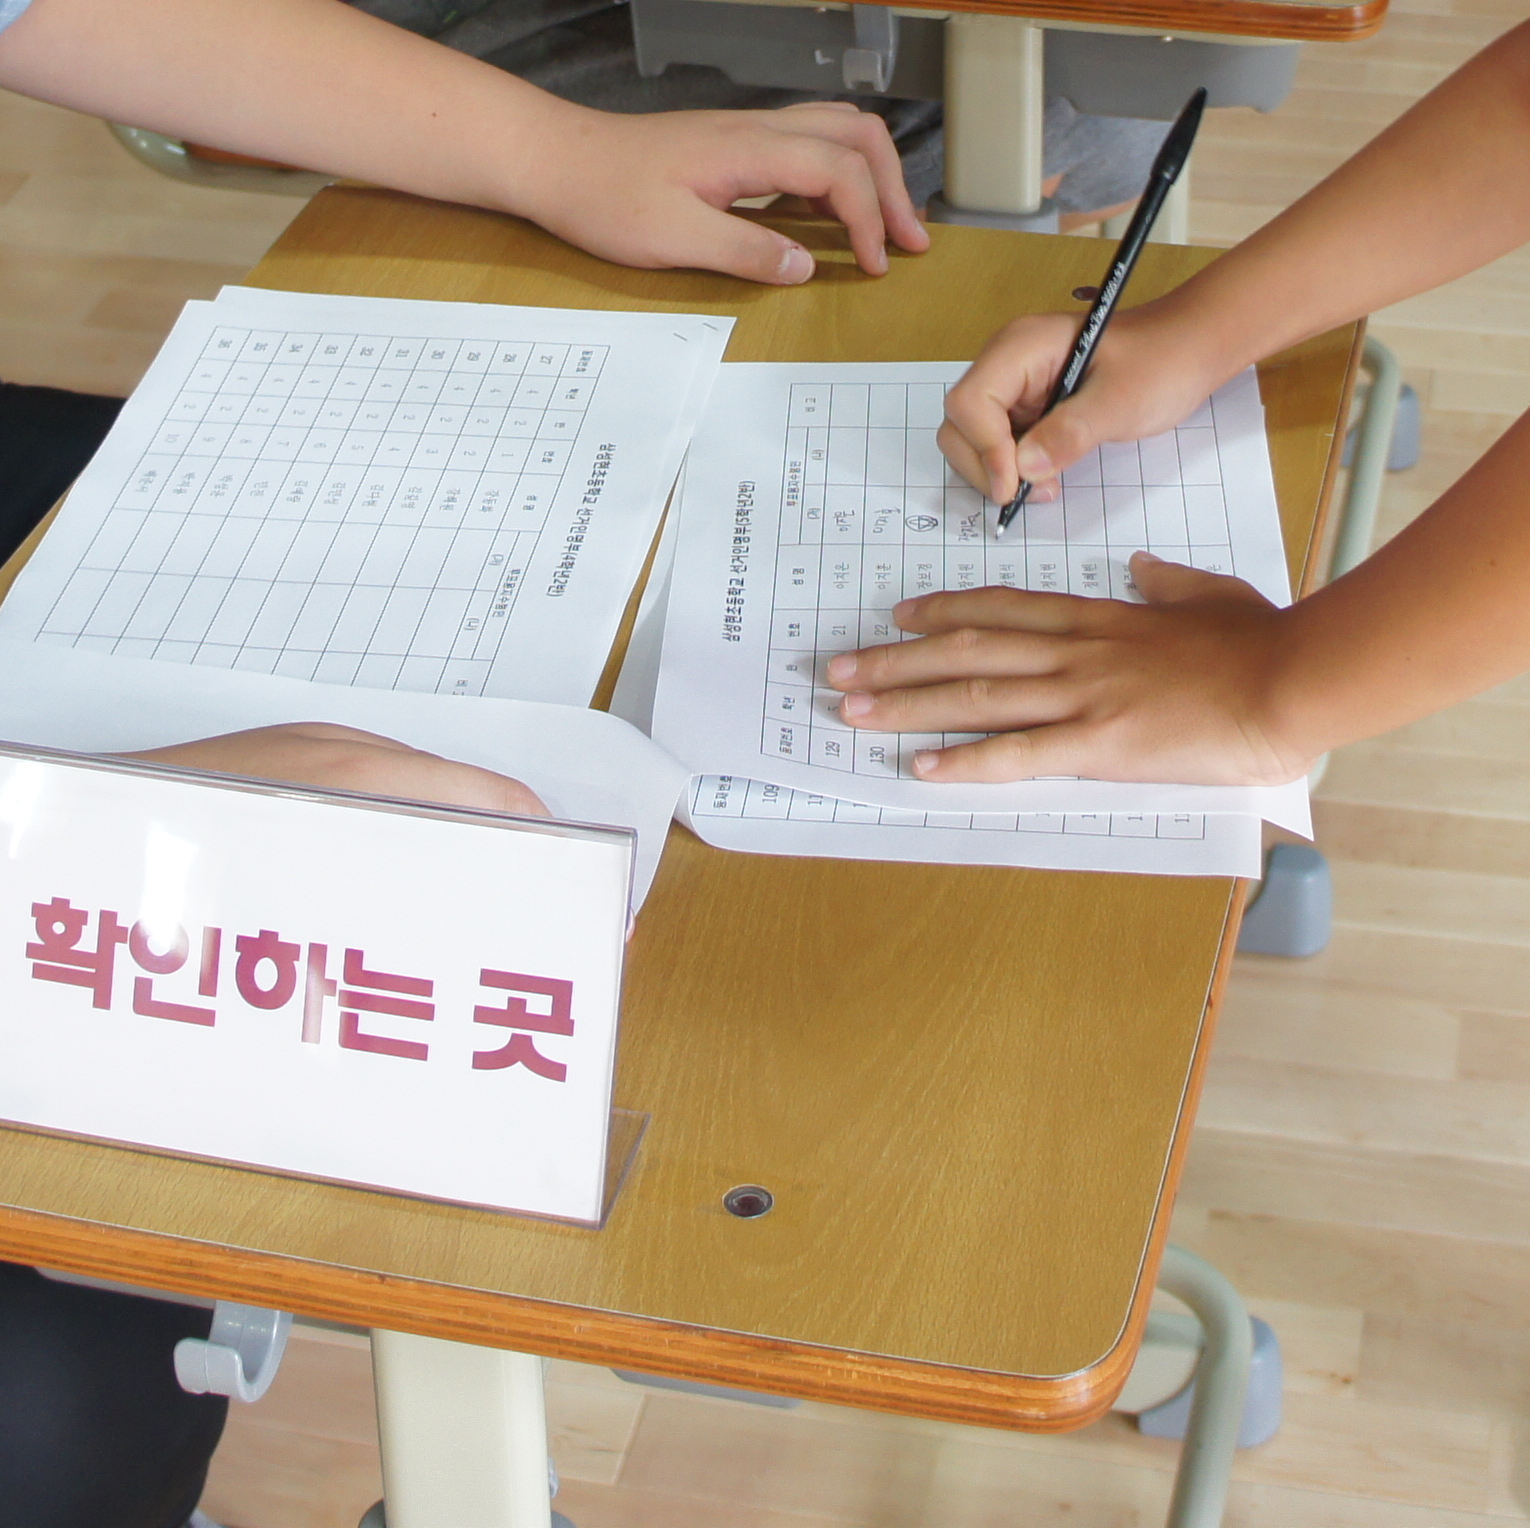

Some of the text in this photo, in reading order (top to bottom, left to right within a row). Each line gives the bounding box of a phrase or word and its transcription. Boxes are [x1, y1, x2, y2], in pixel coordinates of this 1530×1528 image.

[581, 442, 616, 505] 삼성현초등학교
[722, 480, 756, 642] 삼성현초등학교 선거인명부(5학년2반)
[831, 624, 847, 636] 21
[869, 623, 889, 765] 130 22
[824, 740, 841, 758] 129
[25, 897, 435, 1062] 확인하는
[471, 968, 576, 1083] 곳
